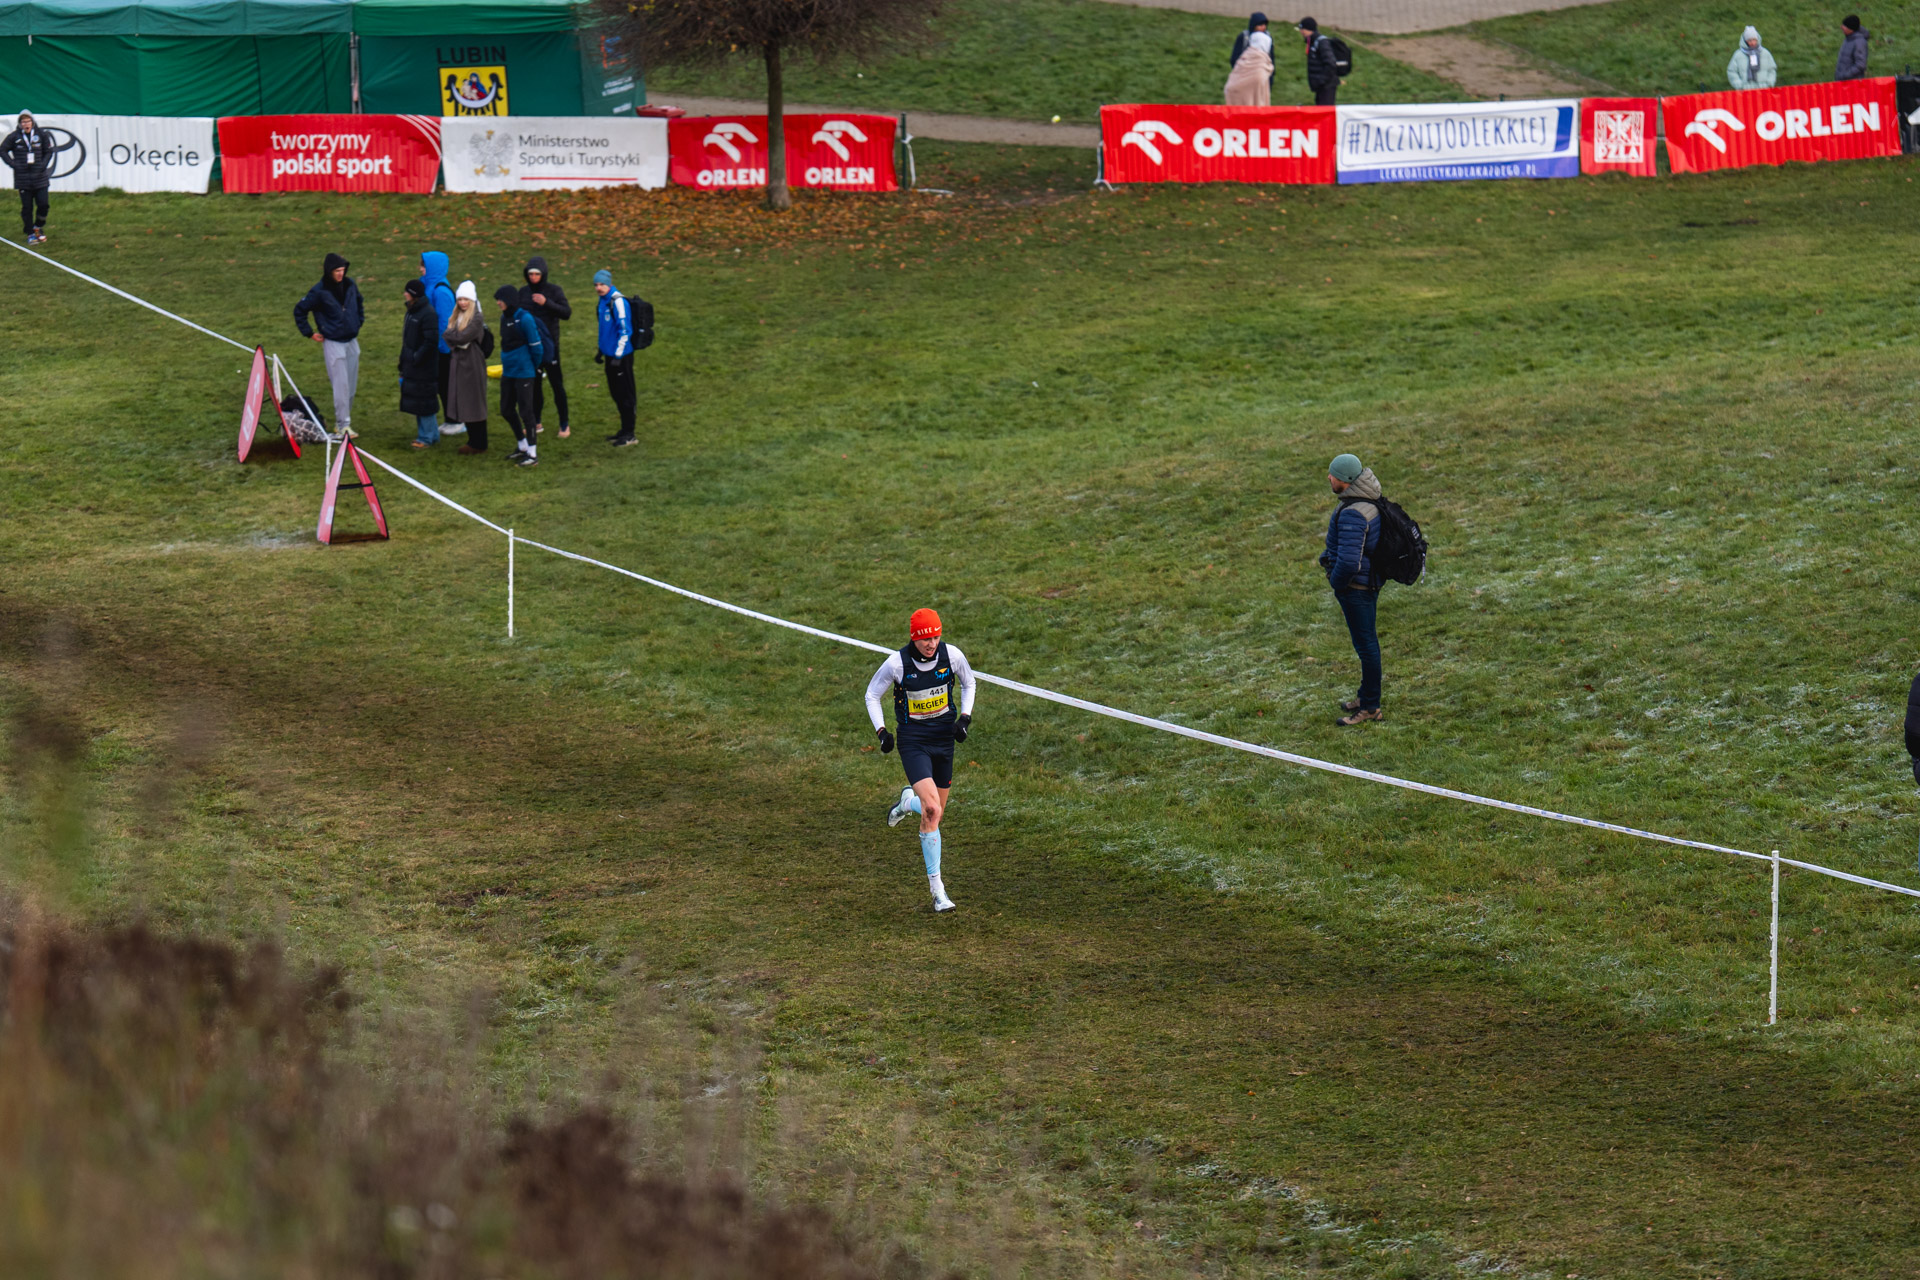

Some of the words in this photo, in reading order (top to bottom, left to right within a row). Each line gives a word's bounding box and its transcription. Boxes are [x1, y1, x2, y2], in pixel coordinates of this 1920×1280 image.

[437, 46, 507, 65] LUBIN
[1755, 102, 1881, 141] ORLEN
[270, 131, 371, 154] tworzymy
[518, 135, 610, 148] Ministerstwo
[1193, 127, 1319, 158] ORLEN
[110, 143, 200, 171] Okęcie
[518, 152, 566, 168] Sportu
[569, 153, 574, 166] i
[578, 153, 640, 168] Turystyki
[1598, 145, 1641, 160] PZLA
[272, 152, 332, 179] polski
[337, 155, 392, 179] sport
[697, 168, 766, 186] ORLEN
[805, 167, 875, 185] ORLEN
[917, 627, 932, 635] NIKE
[929, 687, 944, 696] 441
[912, 698, 944, 710] MEGIER
